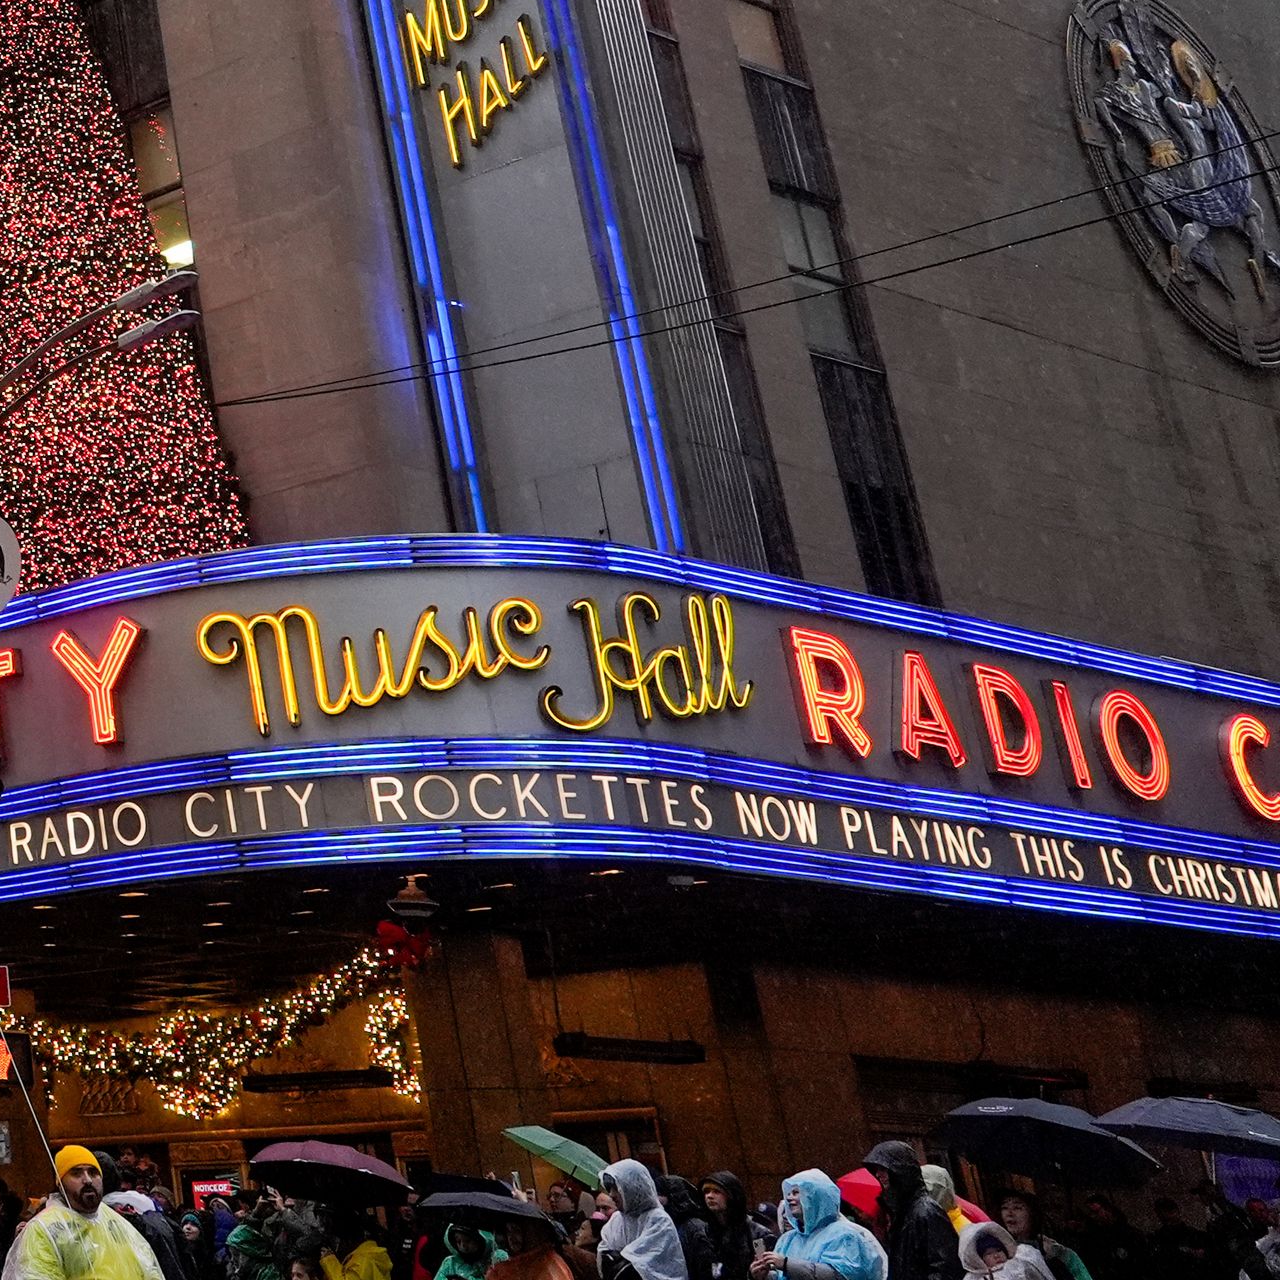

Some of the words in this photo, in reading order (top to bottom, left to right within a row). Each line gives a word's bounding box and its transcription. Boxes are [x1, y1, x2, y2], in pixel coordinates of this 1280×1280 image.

[437, 19, 546, 166] HALL
[196, 604, 550, 738] Music
[538, 590, 754, 732] Hall
[786, 625, 1172, 802] RADIO
[10, 801, 146, 864] RADIO
[184, 781, 316, 838] CITY
[369, 773, 713, 830] ROCKETTES
[735, 790, 818, 845] NOW
[841, 807, 991, 869] PLAYING
[1010, 833, 1085, 882] THIS
[1099, 846, 1132, 889] IS
[194, 1184, 218, 1193] NOTICE
